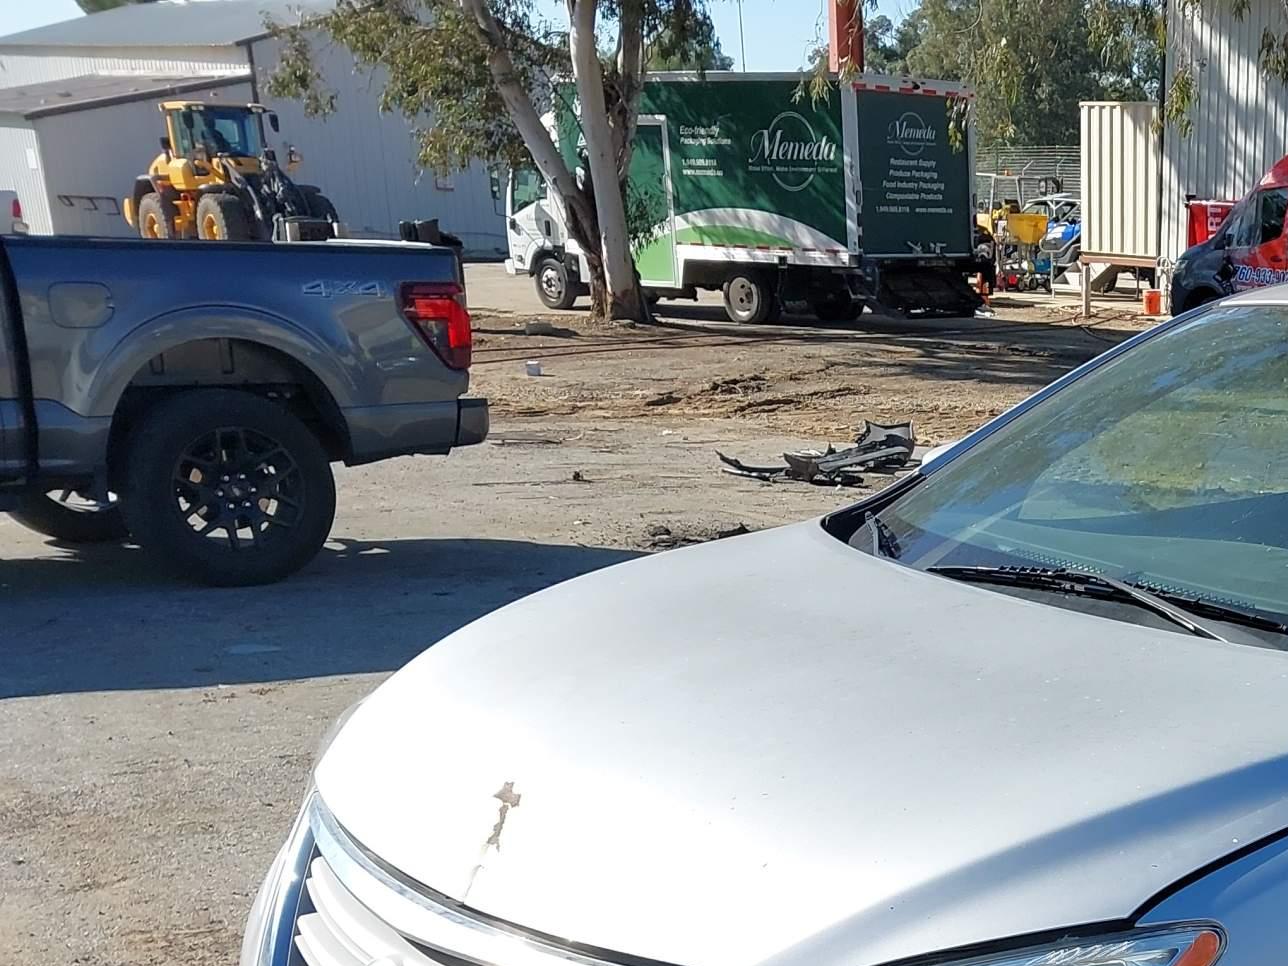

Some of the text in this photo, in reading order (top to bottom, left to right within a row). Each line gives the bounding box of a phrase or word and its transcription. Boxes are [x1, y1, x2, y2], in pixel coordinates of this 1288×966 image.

[680, 123, 719, 137] Eco-friendly
[887, 120, 936, 140] Memeda
[748, 129, 837, 163] Memeda
